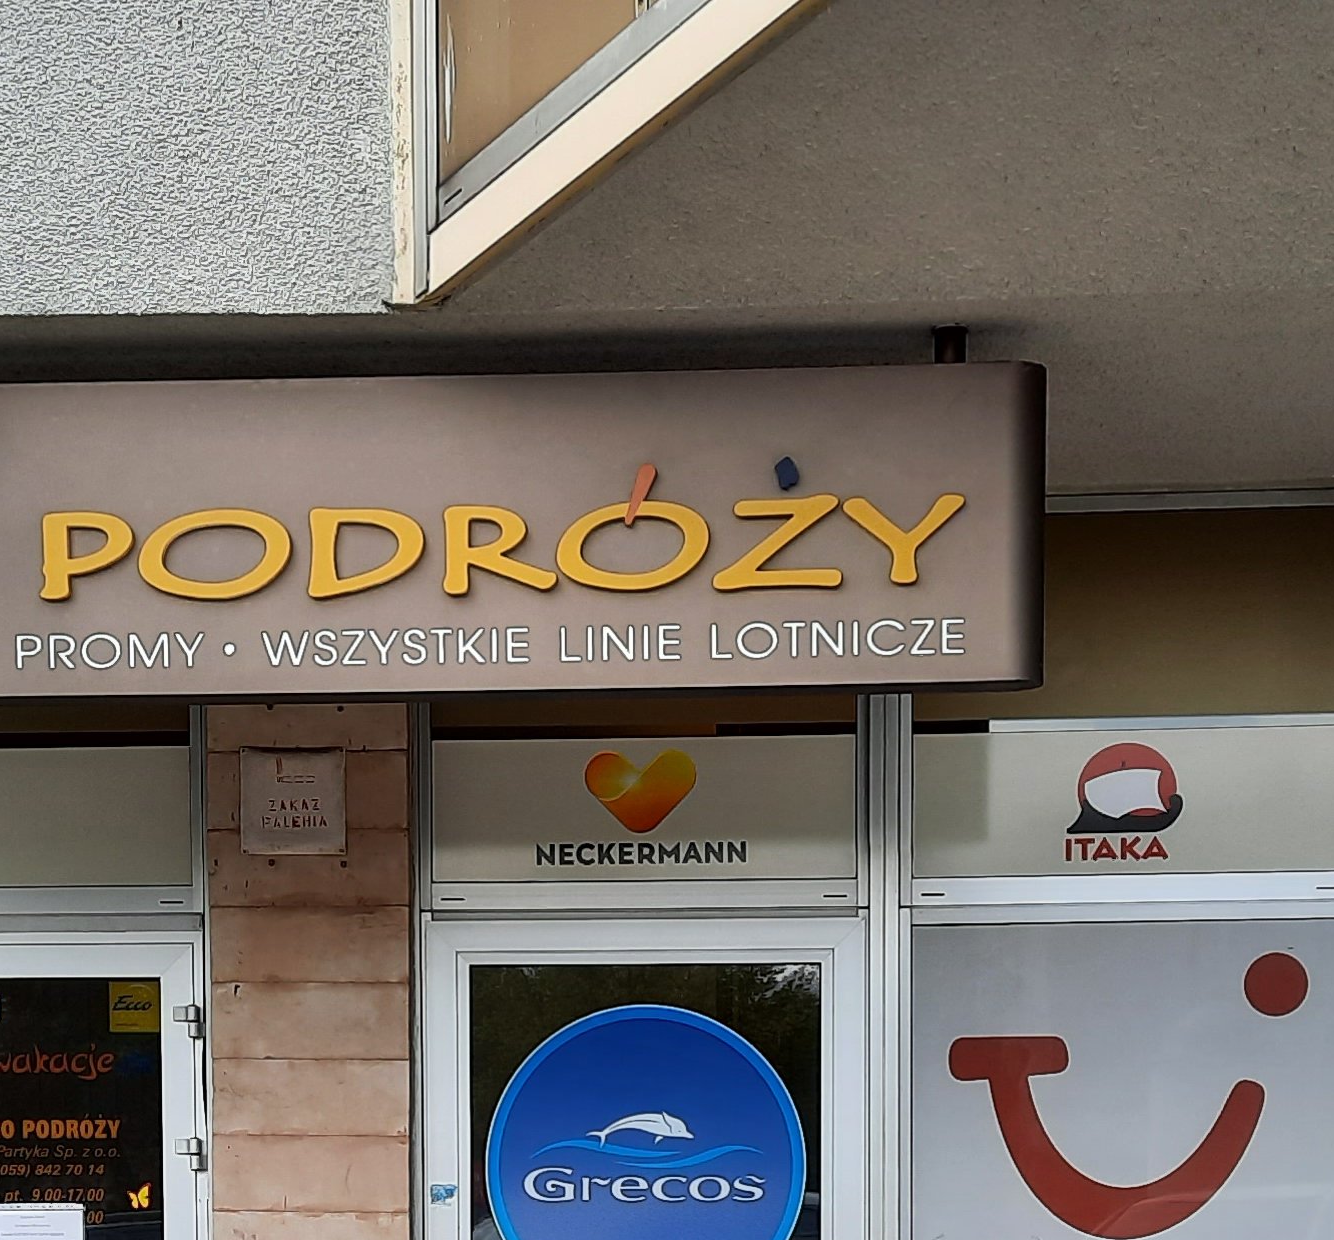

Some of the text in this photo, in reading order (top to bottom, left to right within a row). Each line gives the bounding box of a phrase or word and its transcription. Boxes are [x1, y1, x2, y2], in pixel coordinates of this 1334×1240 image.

[38, 455, 967, 602] PODRÓŻY
[14, 629, 205, 671] PROMY
[262, 625, 530, 667] WSZYSTKIE
[559, 623, 682, 664] LINIE
[710, 618, 967, 661] LOTNICZE
[268, 798, 320, 812] ZAKAZ
[535, 840, 747, 867] NECKERMANN
[1064, 836, 1169, 862] ITAKA
[22, 1113, 120, 1139] PODRÓŻY
[54, 1145, 77, 1160] Sp.
[82, 1149, 90, 1158] z
[94, 1148, 121, 1158] o.o.
[35, 1164, 61, 1176] 842
[66, 1164, 83, 1176] 70
[88, 1164, 105, 1175] 14
[4, 1189, 24, 1203] pt.
[523, 1166, 765, 1202] Grecos
